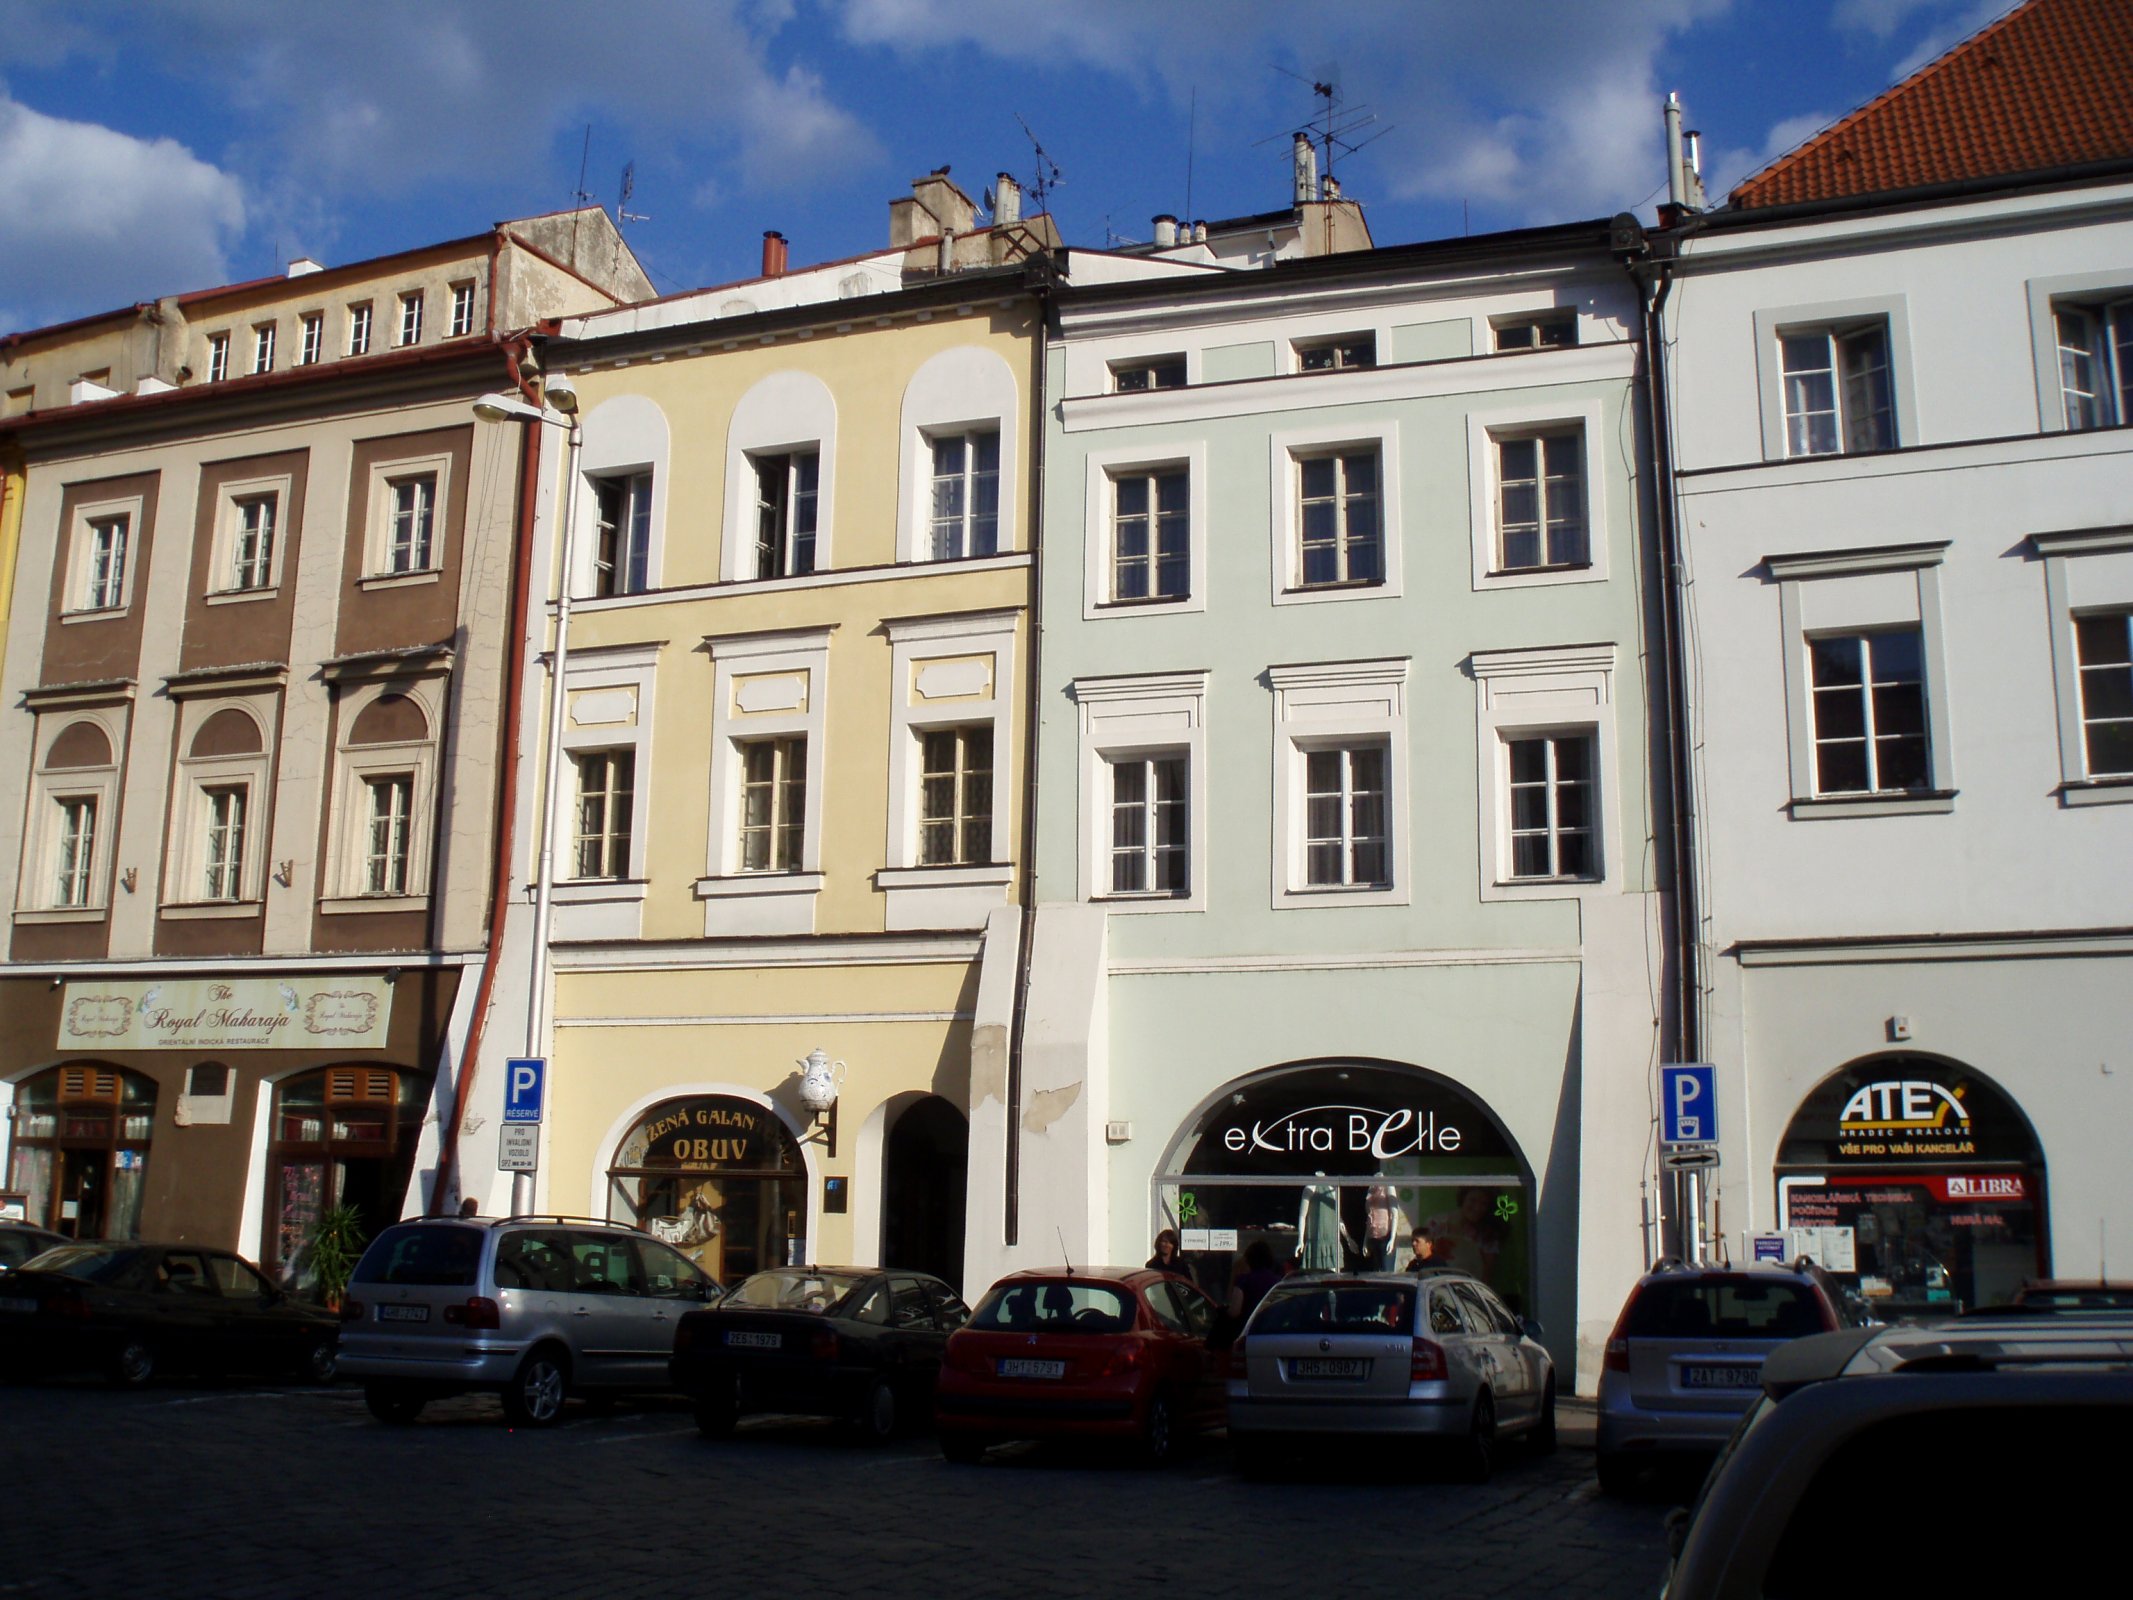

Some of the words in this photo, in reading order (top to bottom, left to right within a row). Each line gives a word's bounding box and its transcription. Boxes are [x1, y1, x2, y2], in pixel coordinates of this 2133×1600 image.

[207, 984, 233, 1001] The
[144, 1008, 206, 1035] Royal
[206, 1008, 290, 1035] Maharaja
[226, 1037, 270, 1045] RESTAURACE
[512, 1067, 536, 1103] P
[1675, 1075, 1700, 1116] P
[1840, 1081, 1968, 1122] ATEX
[1840, 1129, 1894, 1137] HRADEC
[673, 1139, 747, 1160] OBUV
[1839, 1142, 1861, 1155] VŠE
[1863, 1143, 1886, 1155] PRO
[1889, 1142, 1913, 1155] VAŠI
[1916, 1141, 1975, 1154] KANCELÁŘ
[1968, 1178, 2023, 1195] LIBRA
